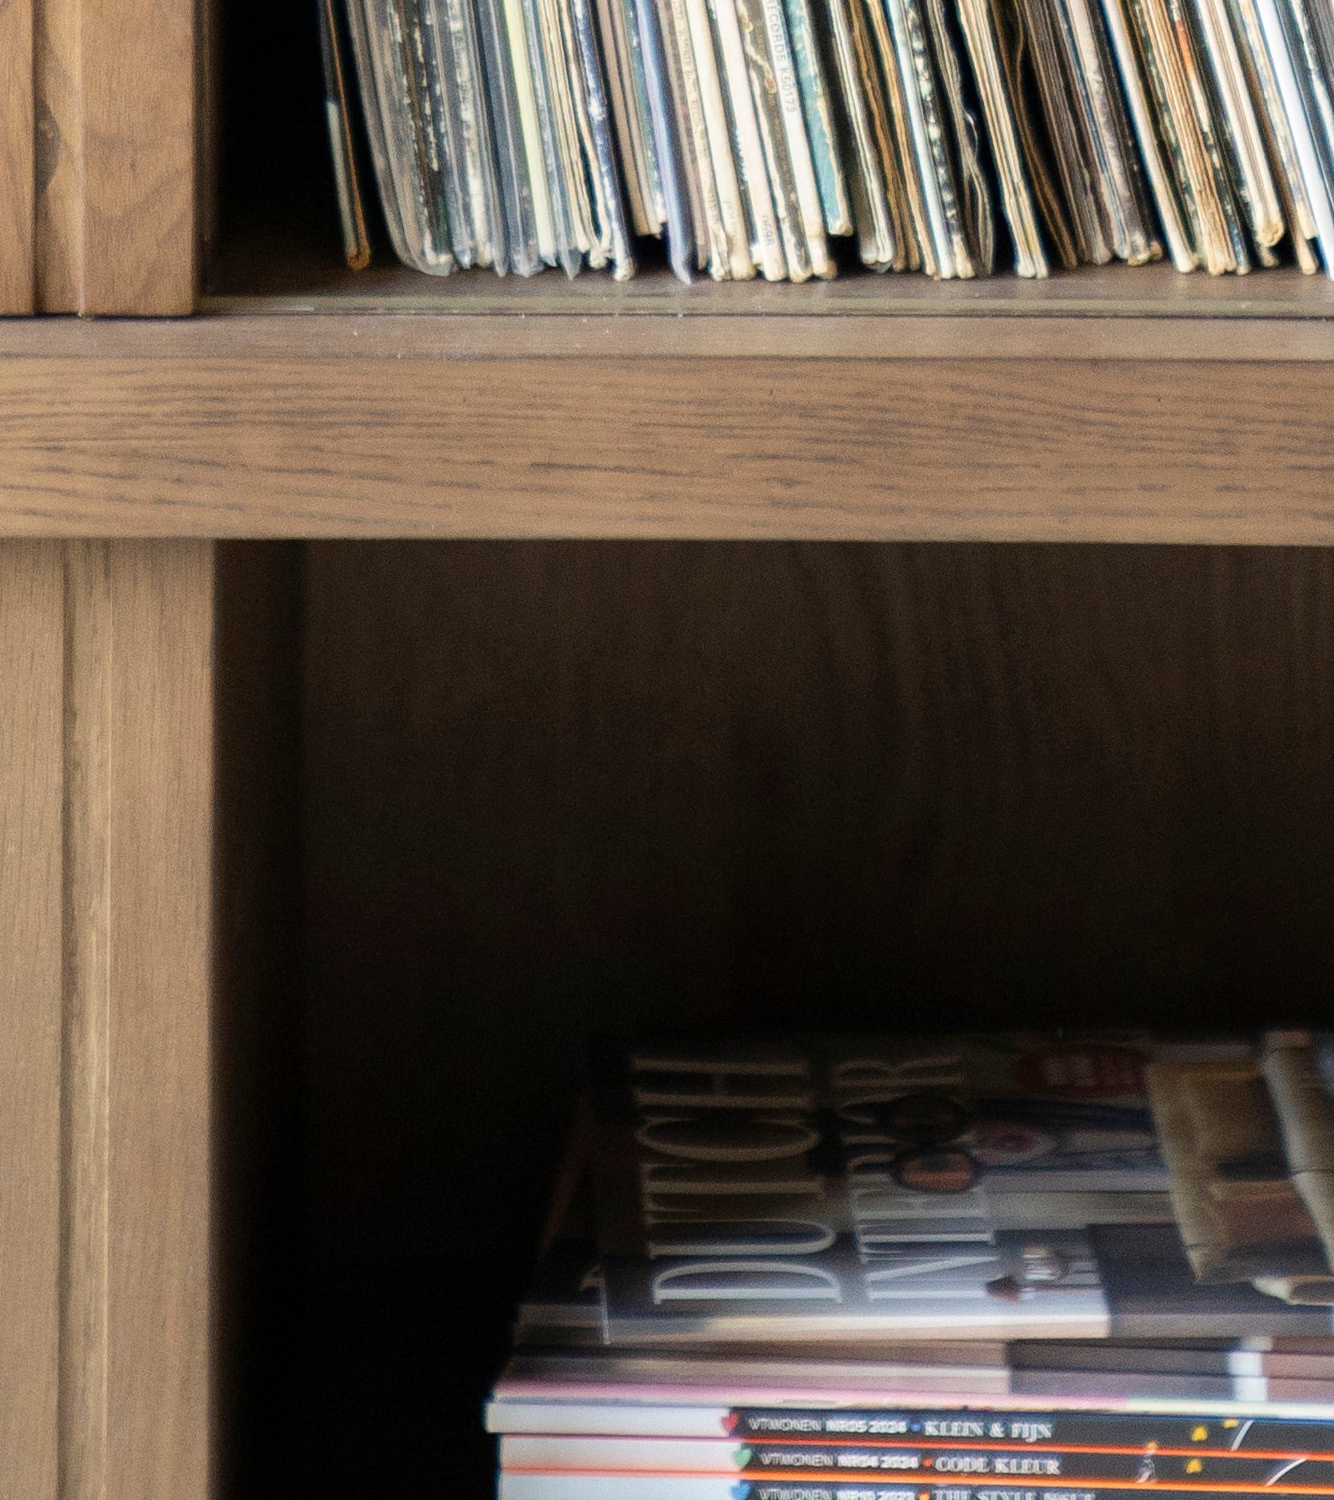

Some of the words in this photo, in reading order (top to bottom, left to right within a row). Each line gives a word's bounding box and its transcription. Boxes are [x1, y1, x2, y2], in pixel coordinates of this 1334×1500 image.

[630, 1055, 844, 1304] DUTCH
[748, 1418, 822, 1431] VTWONEN
[923, 1421, 984, 1436] KLEIN
[989, 1422, 1005, 1438] &
[1011, 1422, 1052, 1443] FIJN
[760, 1452, 834, 1466] VTWONEN
[935, 1456, 989, 1473] CODE
[994, 1457, 1061, 1475] KLEUR
